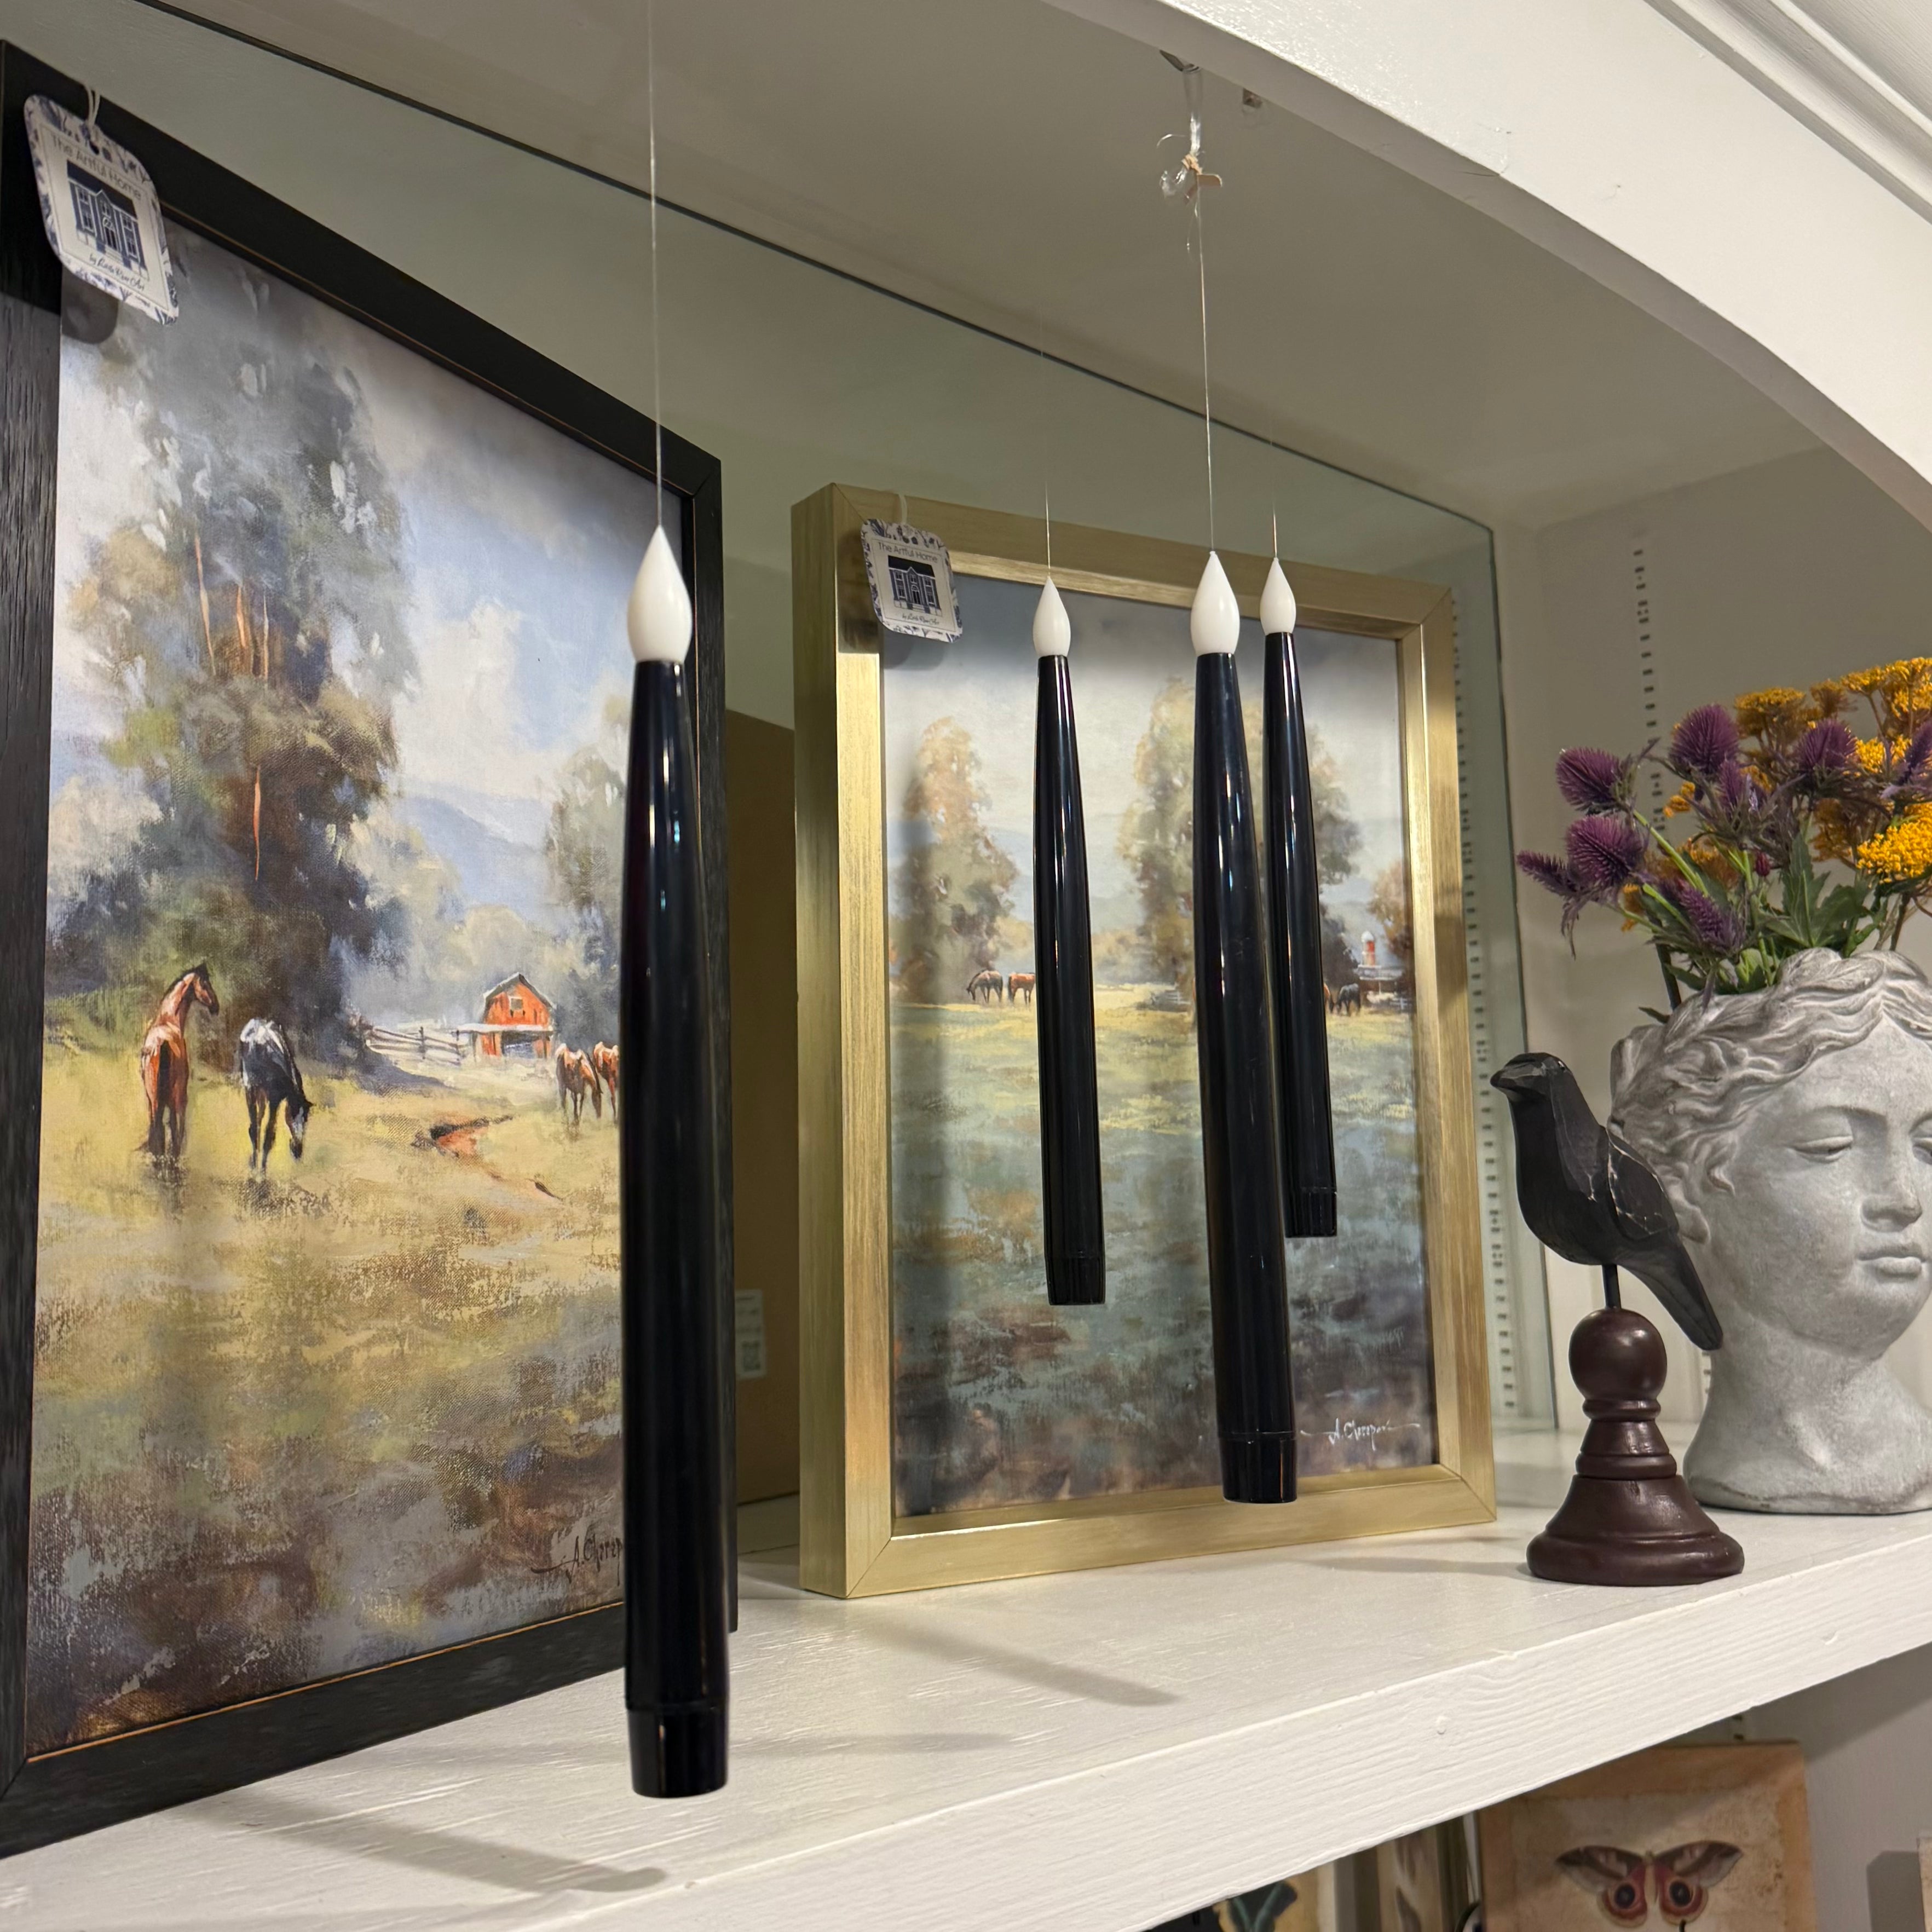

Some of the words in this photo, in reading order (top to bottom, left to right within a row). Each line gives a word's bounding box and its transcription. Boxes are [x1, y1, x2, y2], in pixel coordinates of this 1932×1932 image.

[53, 135, 73, 158] The
[76, 151, 107, 178] Artful
[108, 168, 142, 201] Home
[878, 542, 892, 552] The
[893, 545, 914, 557] Artful
[915, 551, 938, 564] Home
